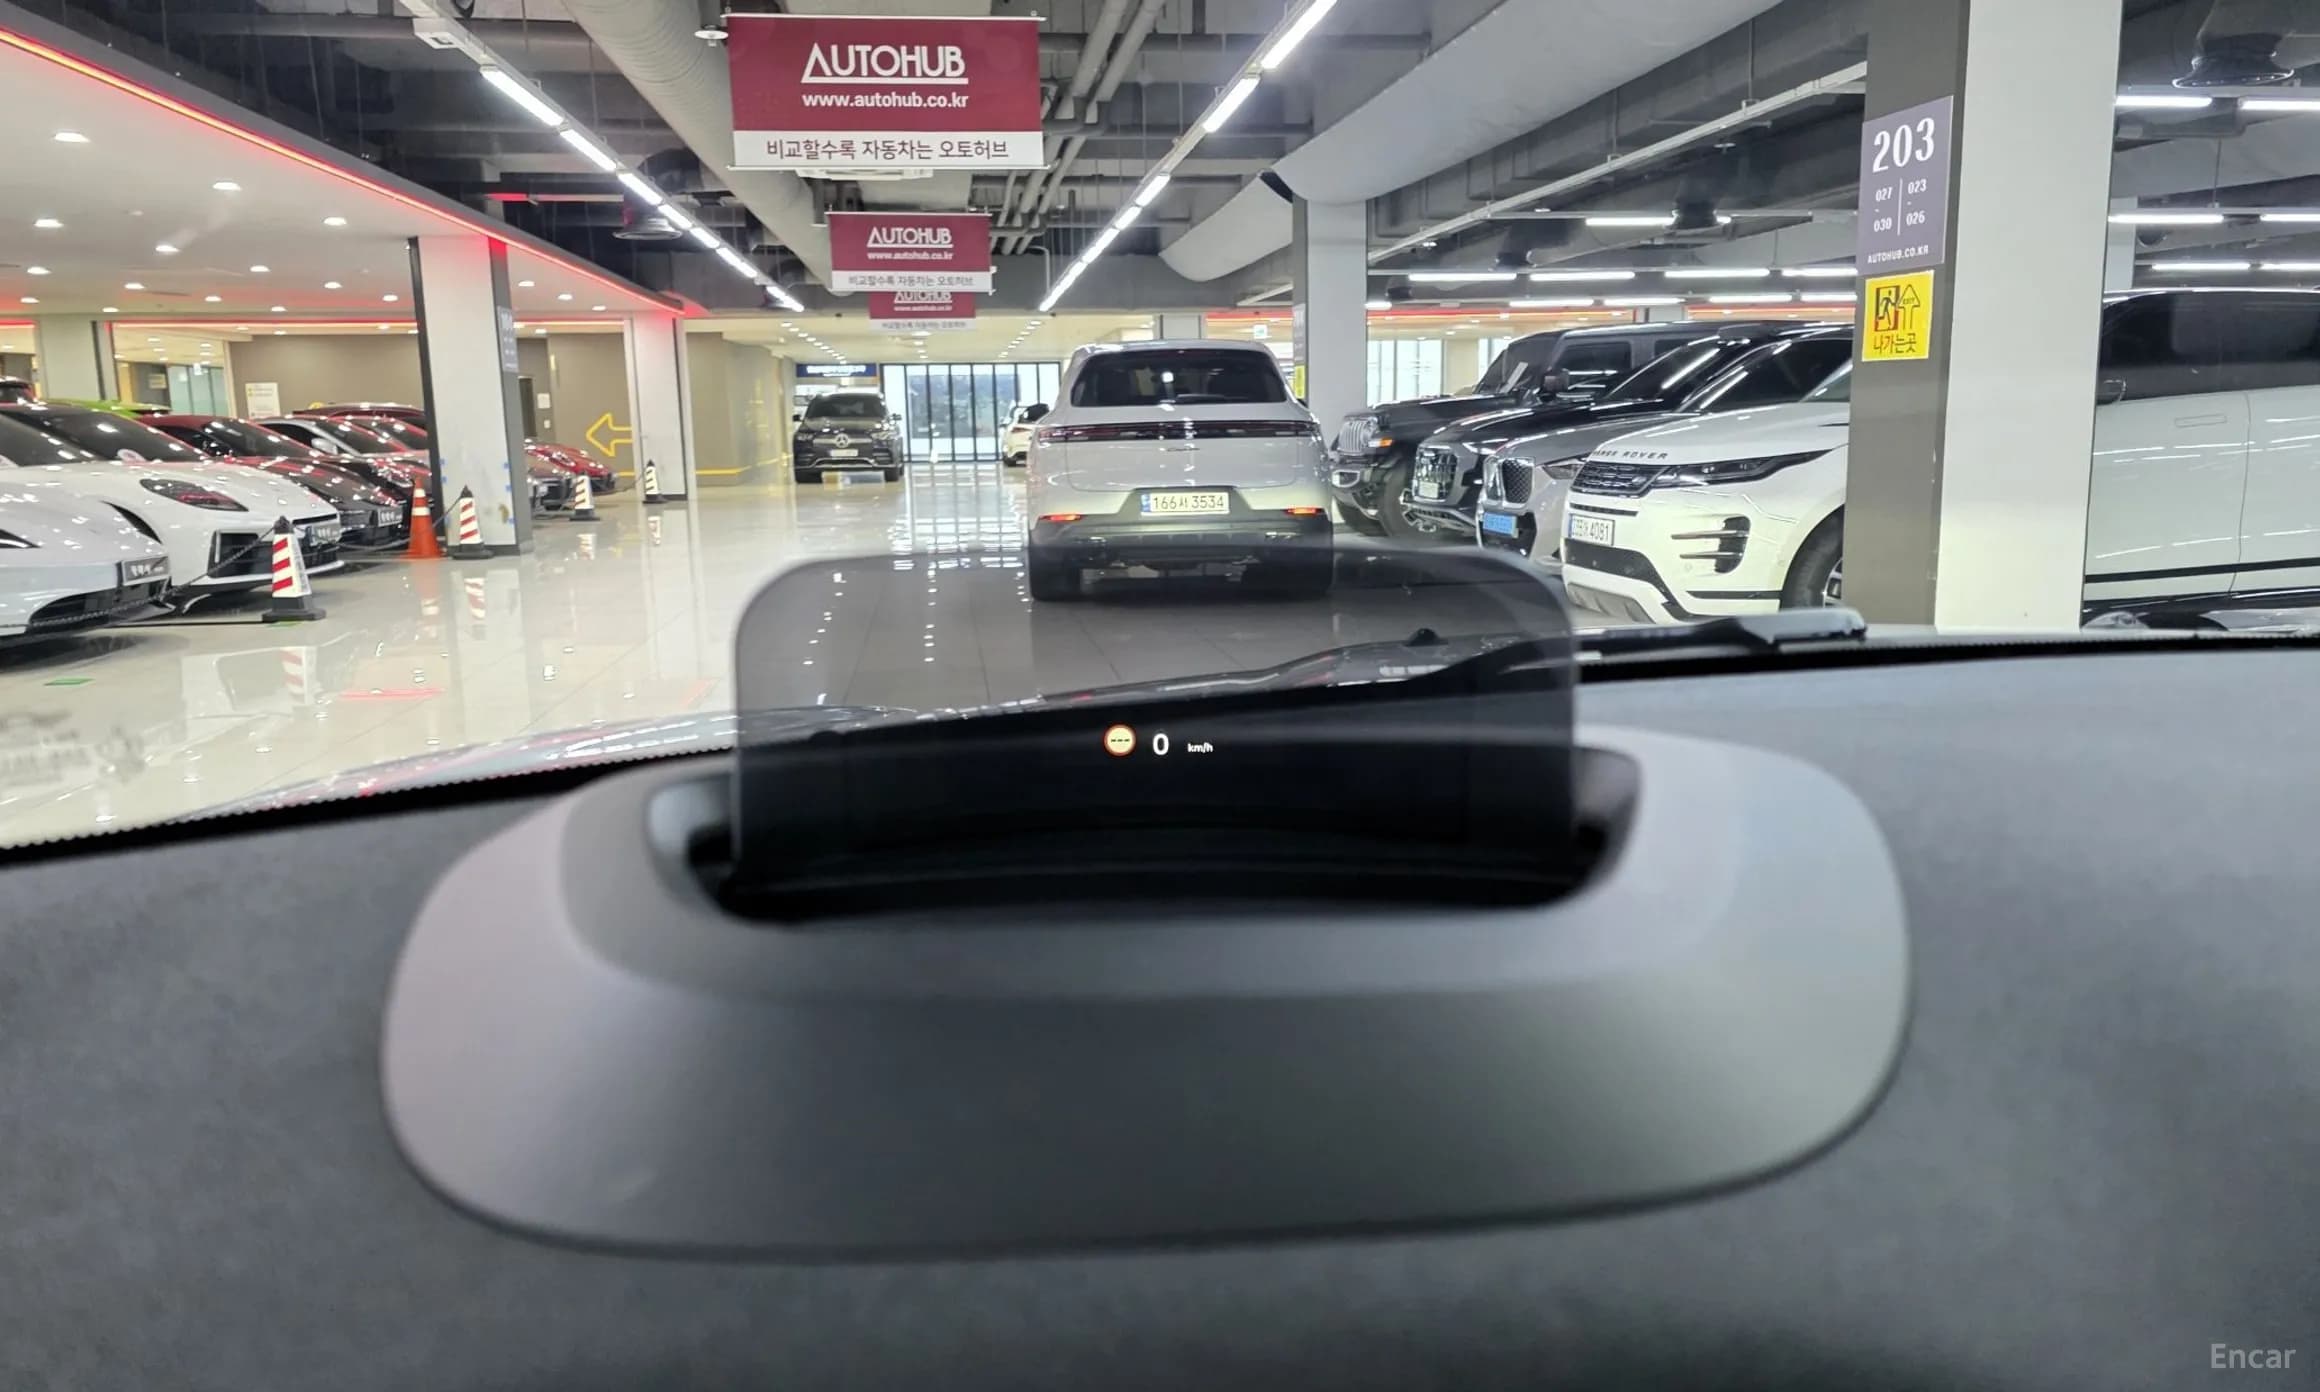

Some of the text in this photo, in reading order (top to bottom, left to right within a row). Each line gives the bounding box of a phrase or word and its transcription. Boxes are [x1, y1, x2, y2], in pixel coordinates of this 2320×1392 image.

[801, 43, 968, 84] AUTOHUB
[802, 91, 968, 108] www.autohub.co.kr
[767, 139, 1009, 160] 비교할수록 자동차는 오토허브
[1873, 117, 1935, 173] 203
[1875, 186, 1893, 202] 027
[1907, 178, 1927, 195] 023
[1873, 217, 1892, 232] 030
[1906, 210, 1925, 226] 026
[866, 226, 954, 248] AUTOHUB
[1867, 244, 1929, 264] AUTOHUB.CO.KR
[1873, 332, 1917, 354] 나가는곳
[1152, 732, 1213, 756] 0 km/h
